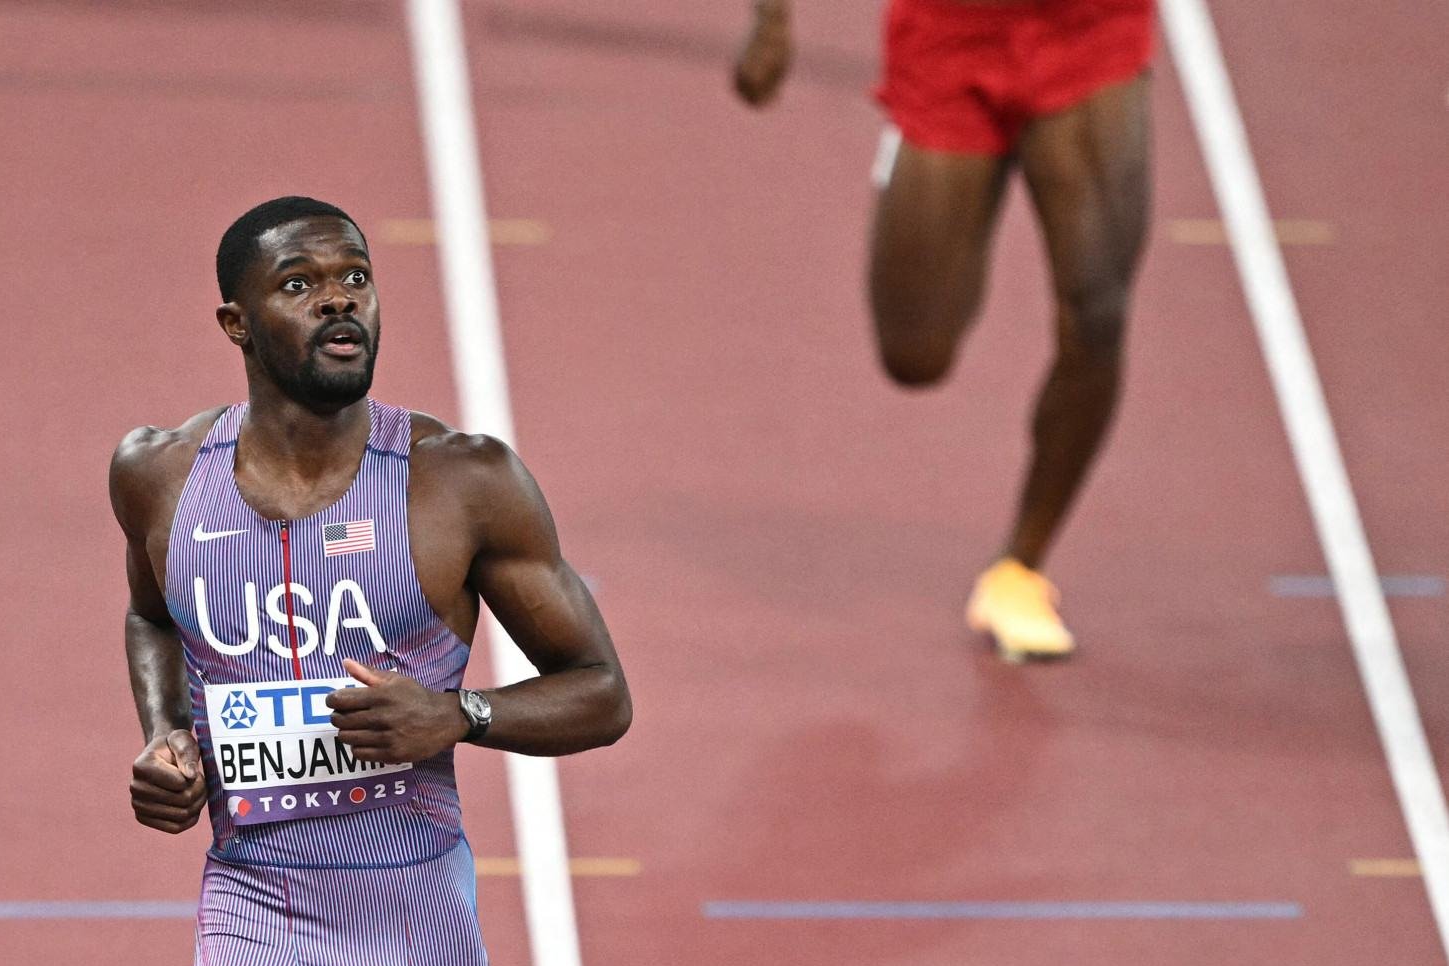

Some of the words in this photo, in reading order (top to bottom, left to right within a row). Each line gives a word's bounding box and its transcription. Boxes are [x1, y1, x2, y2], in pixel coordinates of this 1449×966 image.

[193, 576, 387, 659] USA
[256, 684, 356, 727] TD
[220, 736, 400, 784] BENJAM
